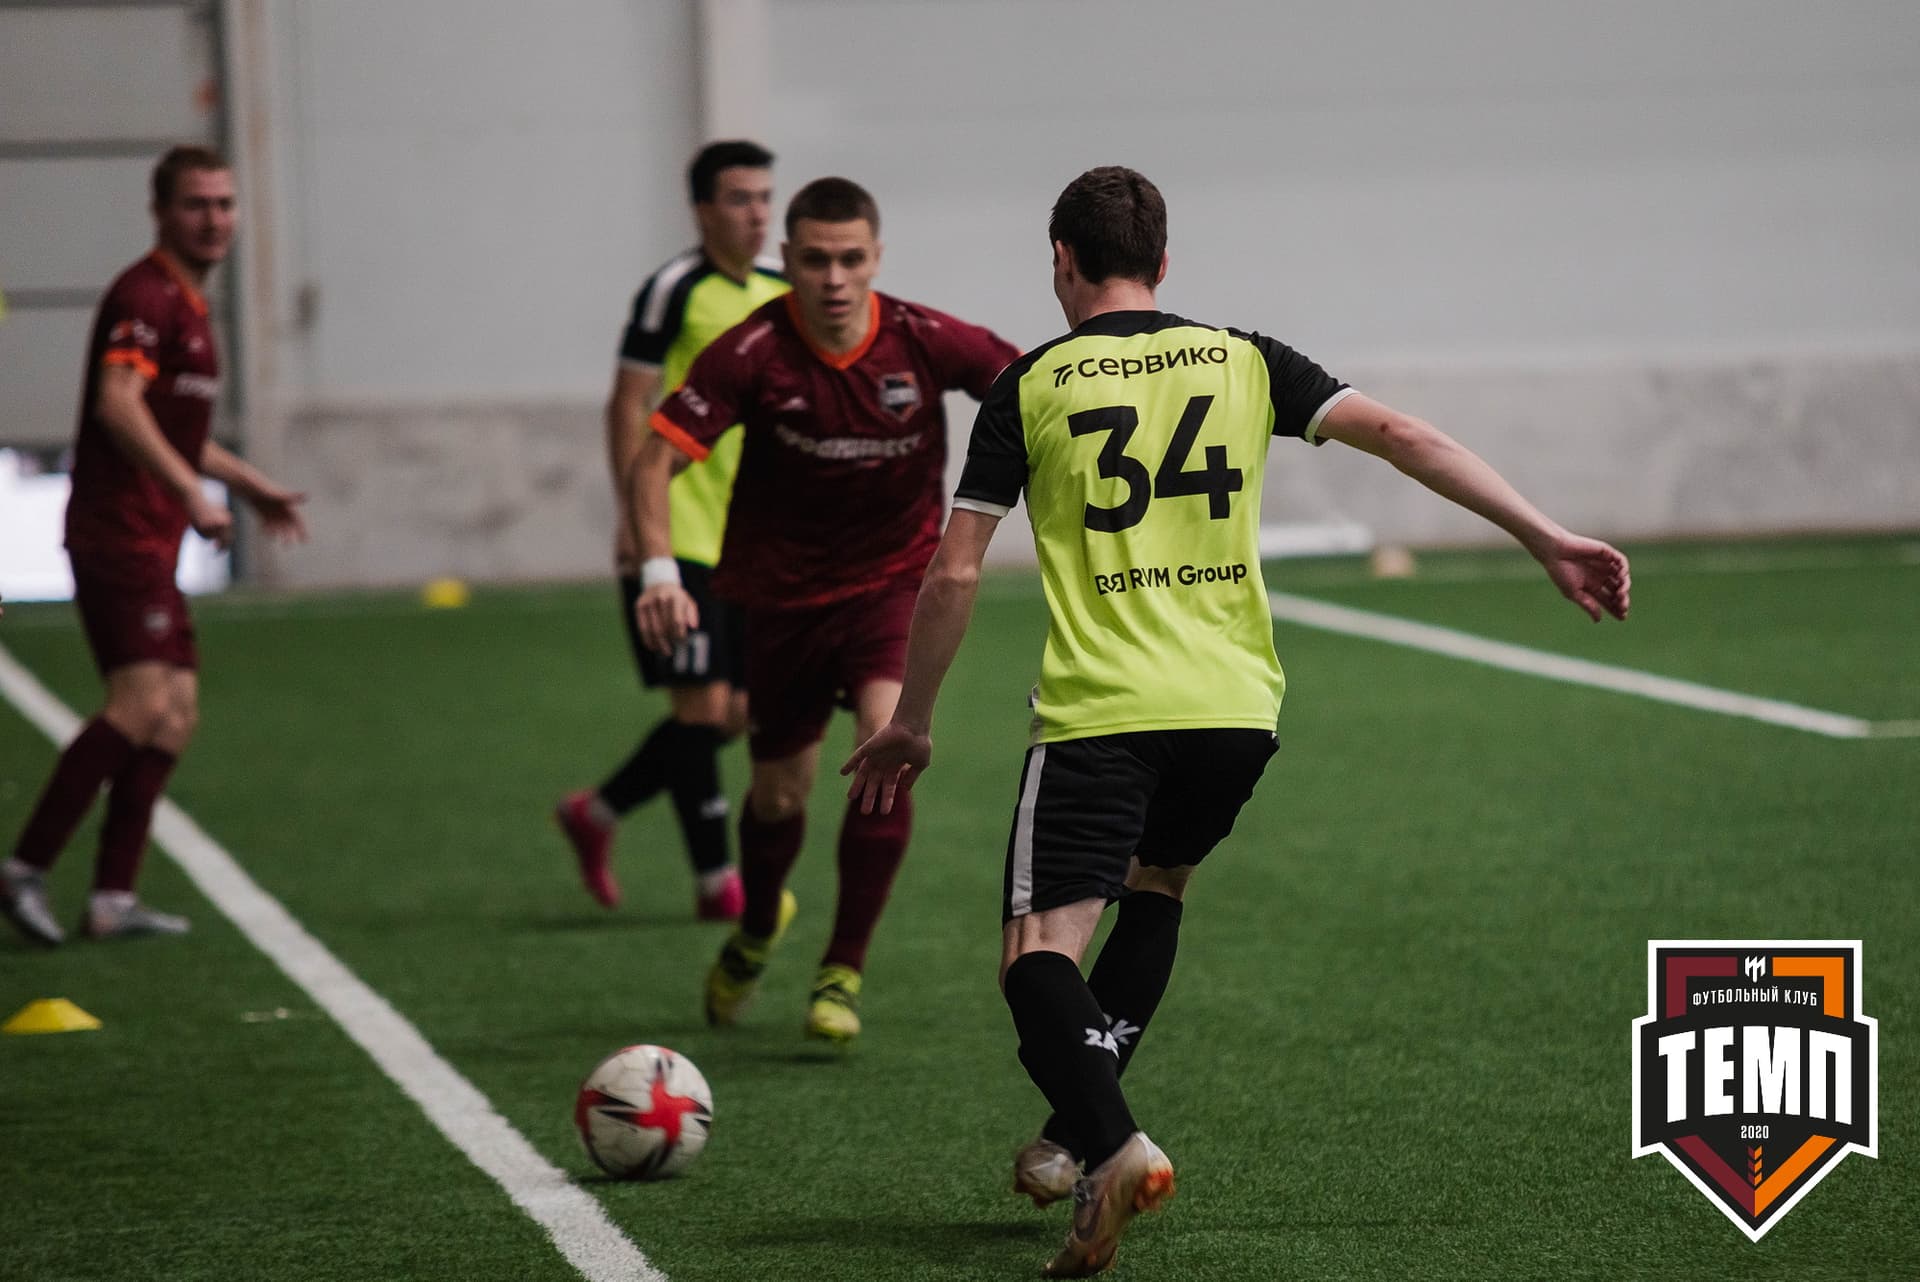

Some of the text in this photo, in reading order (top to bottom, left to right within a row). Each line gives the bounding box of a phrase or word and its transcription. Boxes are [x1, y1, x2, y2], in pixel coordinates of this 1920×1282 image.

[1067, 394, 1243, 533] 34
[1129, 564, 1247, 589] RVM Group
